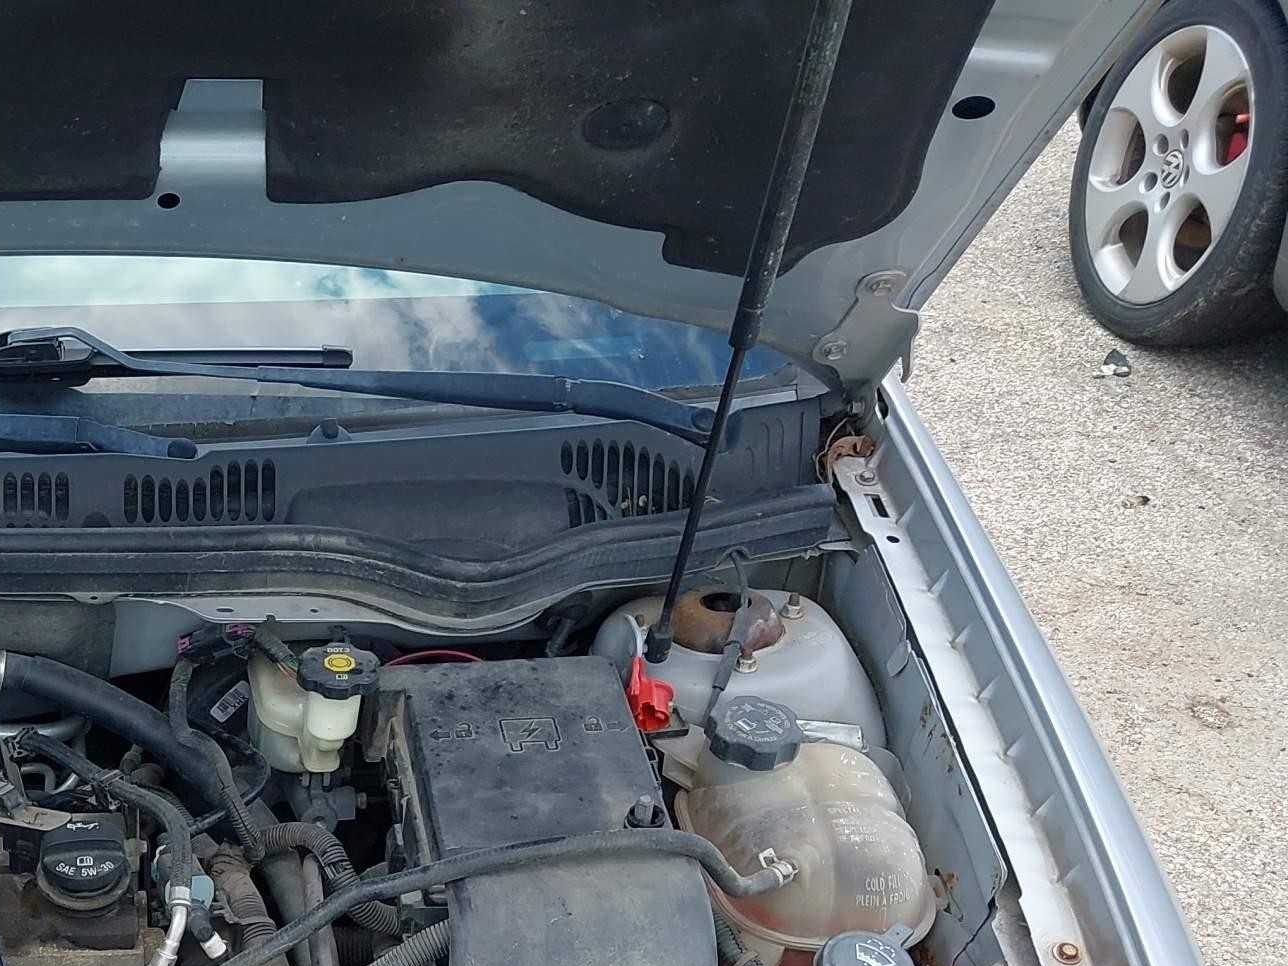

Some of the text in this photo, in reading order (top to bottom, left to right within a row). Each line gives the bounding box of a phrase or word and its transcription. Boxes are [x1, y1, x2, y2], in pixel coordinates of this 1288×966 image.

[55, 861, 114, 877] SAE 5W-30
[865, 876, 885, 892] COLD
